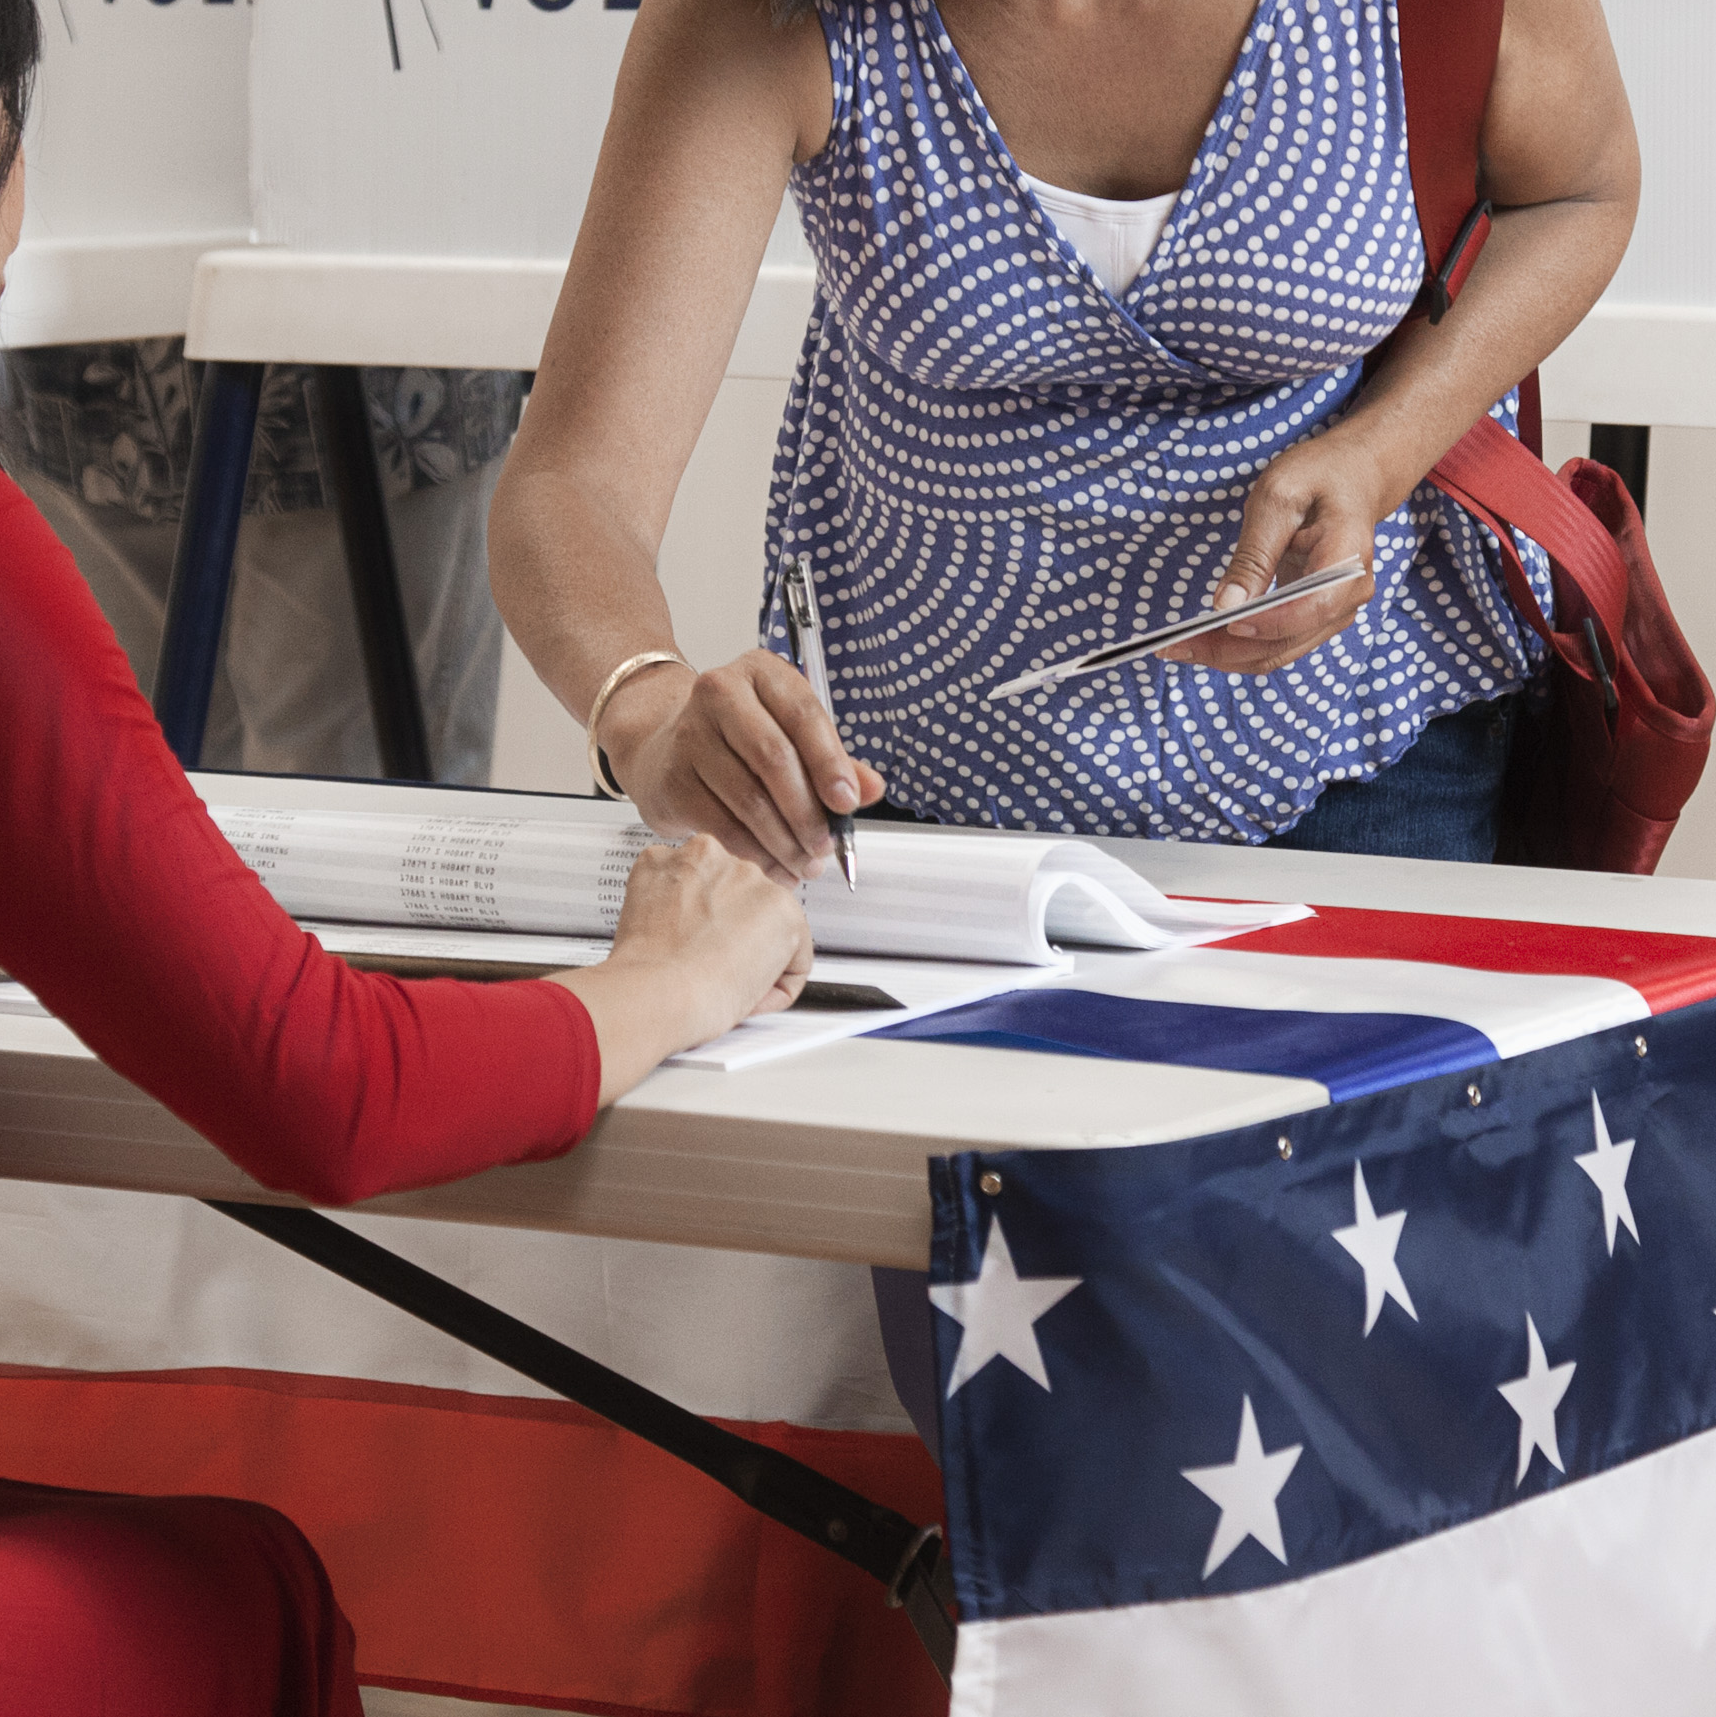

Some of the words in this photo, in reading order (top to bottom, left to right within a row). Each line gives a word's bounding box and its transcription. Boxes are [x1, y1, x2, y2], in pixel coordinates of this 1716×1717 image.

[221, 830, 256, 839] ADELINE
[449, 836, 481, 845] HOBART
[483, 839, 505, 847] BLVD
[254, 845, 289, 855] MANNING
[435, 847, 441, 855] S
[444, 849, 474, 858] HOBART
[478, 852, 499, 861] BLVD
[431, 861, 436, 870] S
[440, 863, 470, 875] HOBART
[475, 865, 495, 875] BLVD
[600, 863, 631, 873] GARDEN
[429, 876, 434, 885] S
[439, 878, 469, 888] HOBART
[474, 880, 494, 890] BLVD
[597, 877, 627, 888] GARDEN
[430, 891, 436, 899] S
[440, 892, 470, 902] HOBART
[475, 895, 496, 905] BLVD
[597, 893, 624, 903] GARDE
[443, 906, 474, 914] HOBART
[599, 907, 621, 916] GARD
